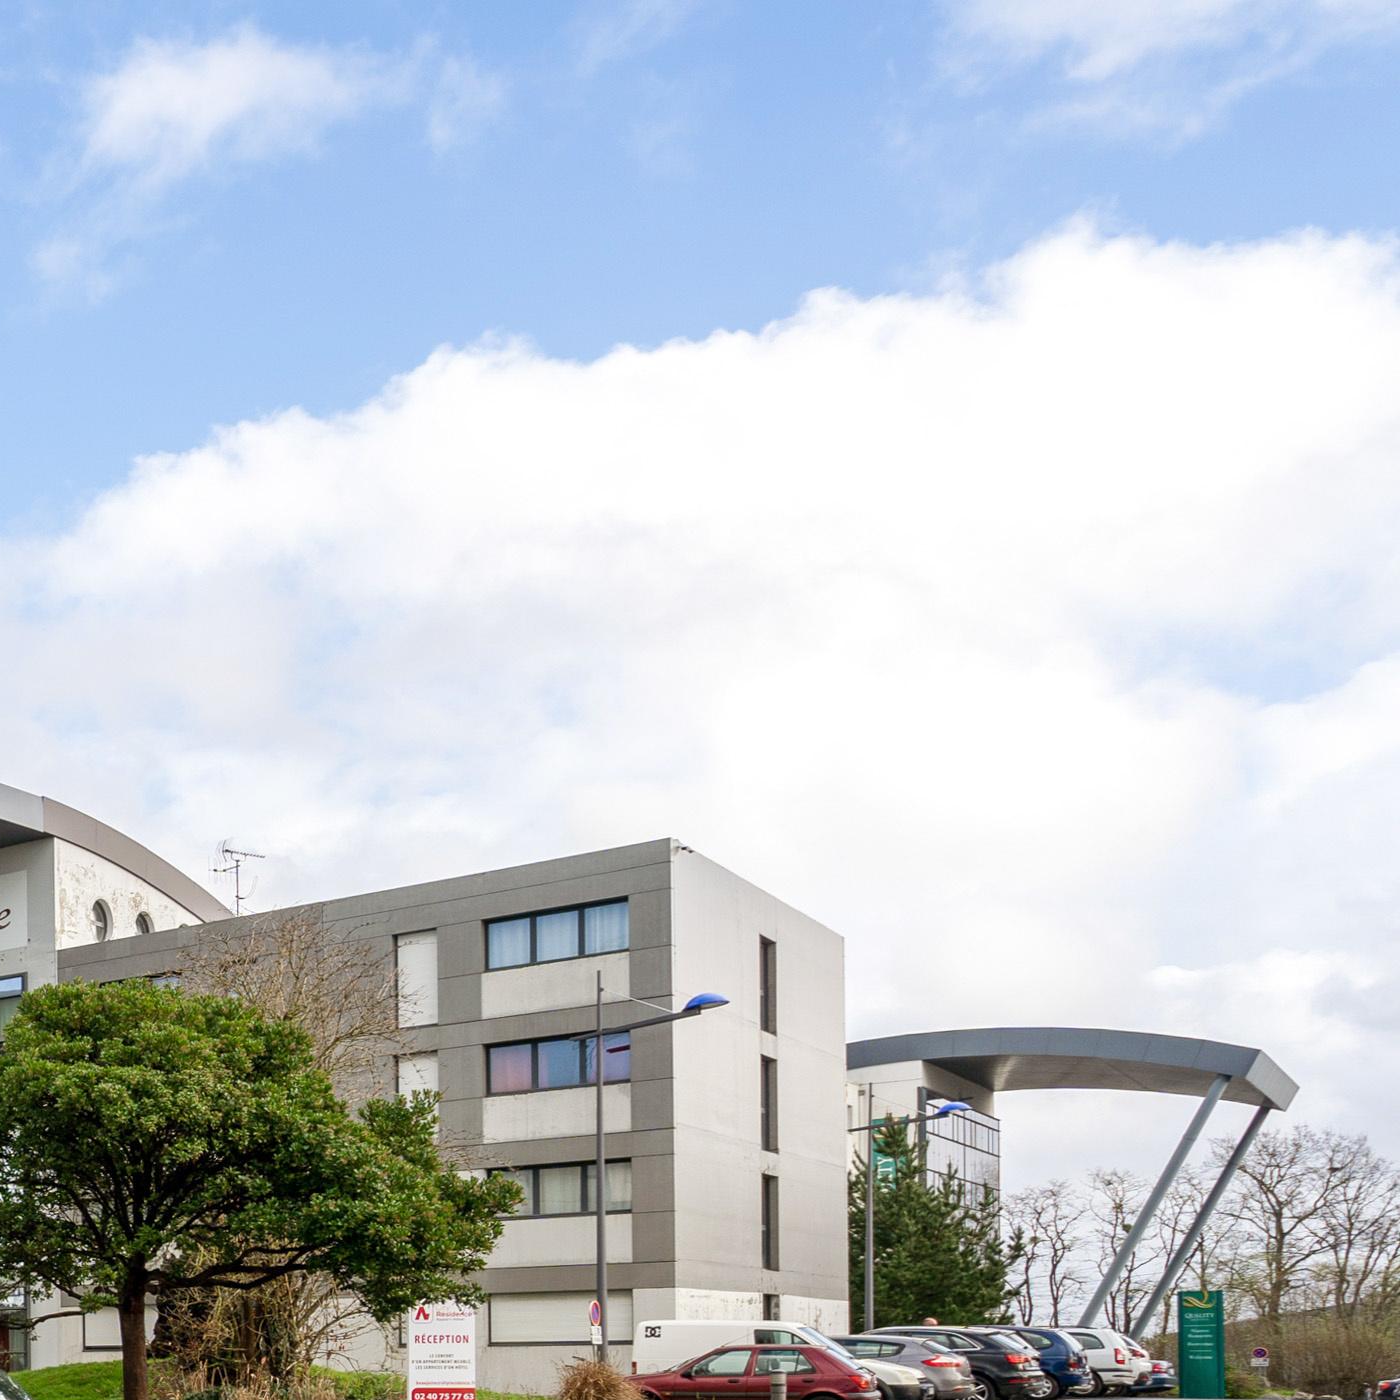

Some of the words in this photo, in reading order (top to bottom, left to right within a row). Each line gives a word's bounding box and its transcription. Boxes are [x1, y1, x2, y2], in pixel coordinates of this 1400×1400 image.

[414, 1333, 469, 1344] RÉCEPTION
[414, 1393, 426, 1400] 02
[426, 1393, 438, 1400] 40
[439, 1393, 450, 1400] 75
[451, 1393, 463, 1400] 77
[463, 1393, 475, 1400] 63
